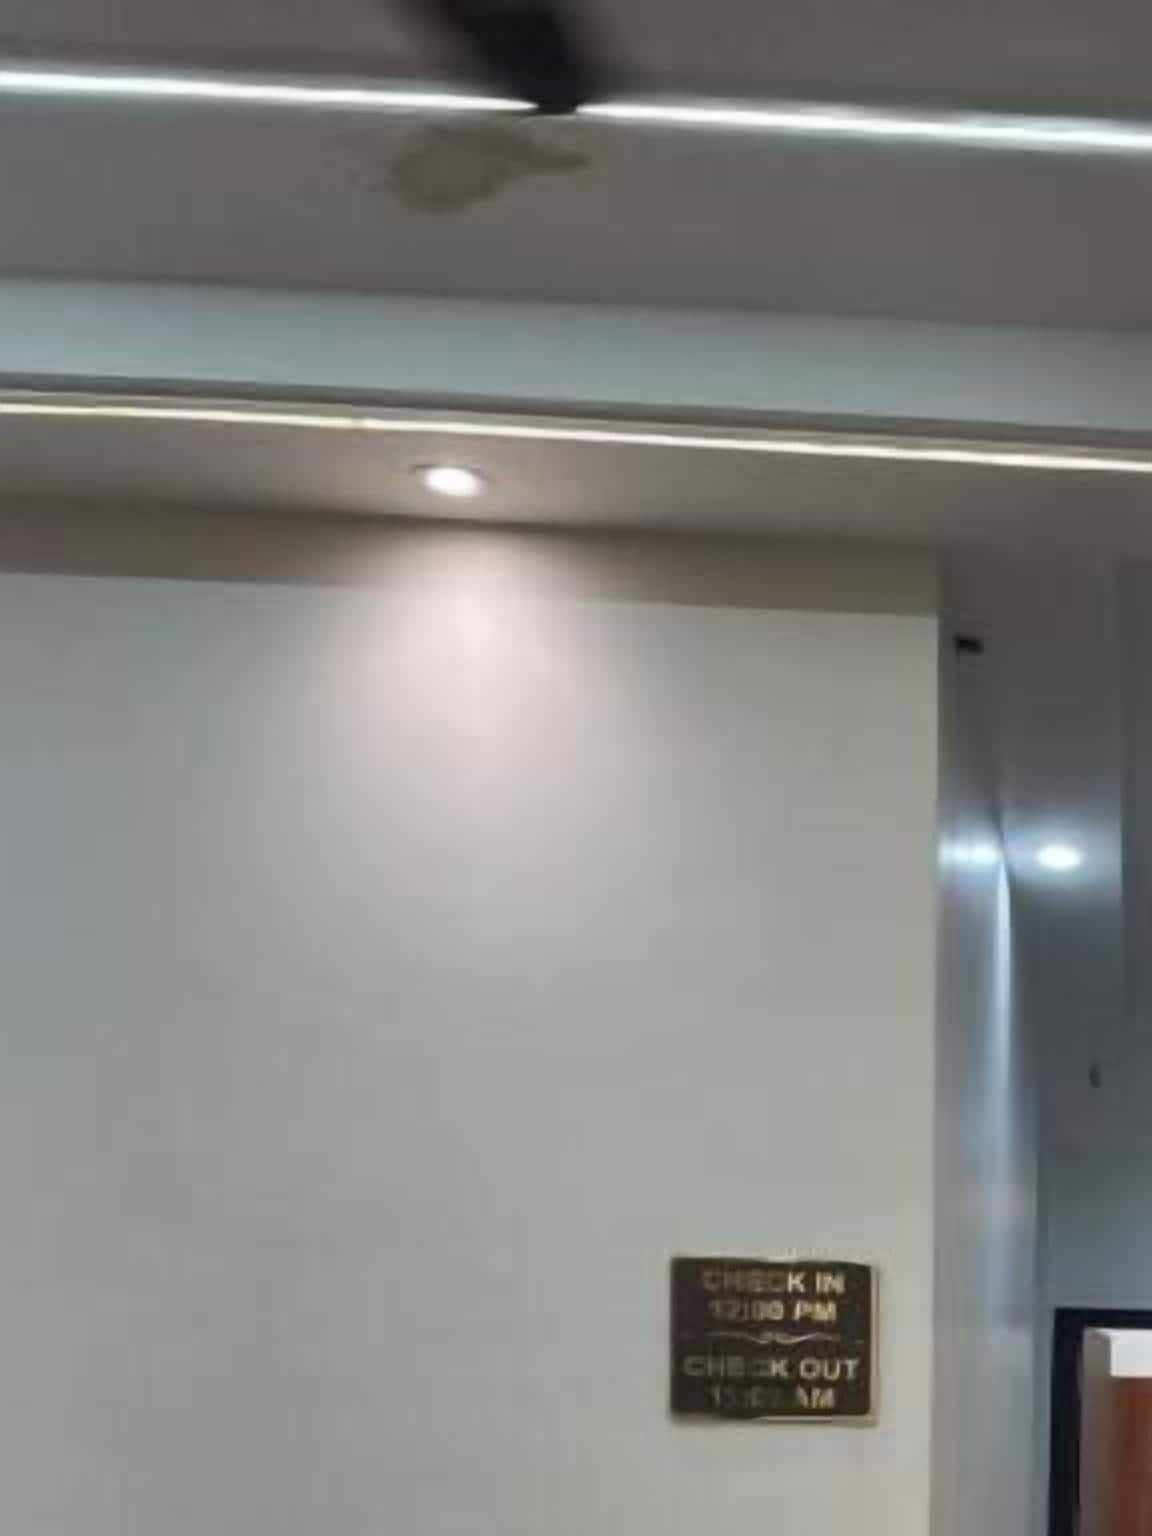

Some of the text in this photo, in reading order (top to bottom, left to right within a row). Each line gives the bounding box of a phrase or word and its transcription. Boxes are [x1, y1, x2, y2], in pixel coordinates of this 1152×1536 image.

[702, 1269, 847, 1294] CHECK IN
[793, 1300, 837, 1322] PM
[683, 1355, 860, 1382] CHECK OUT
